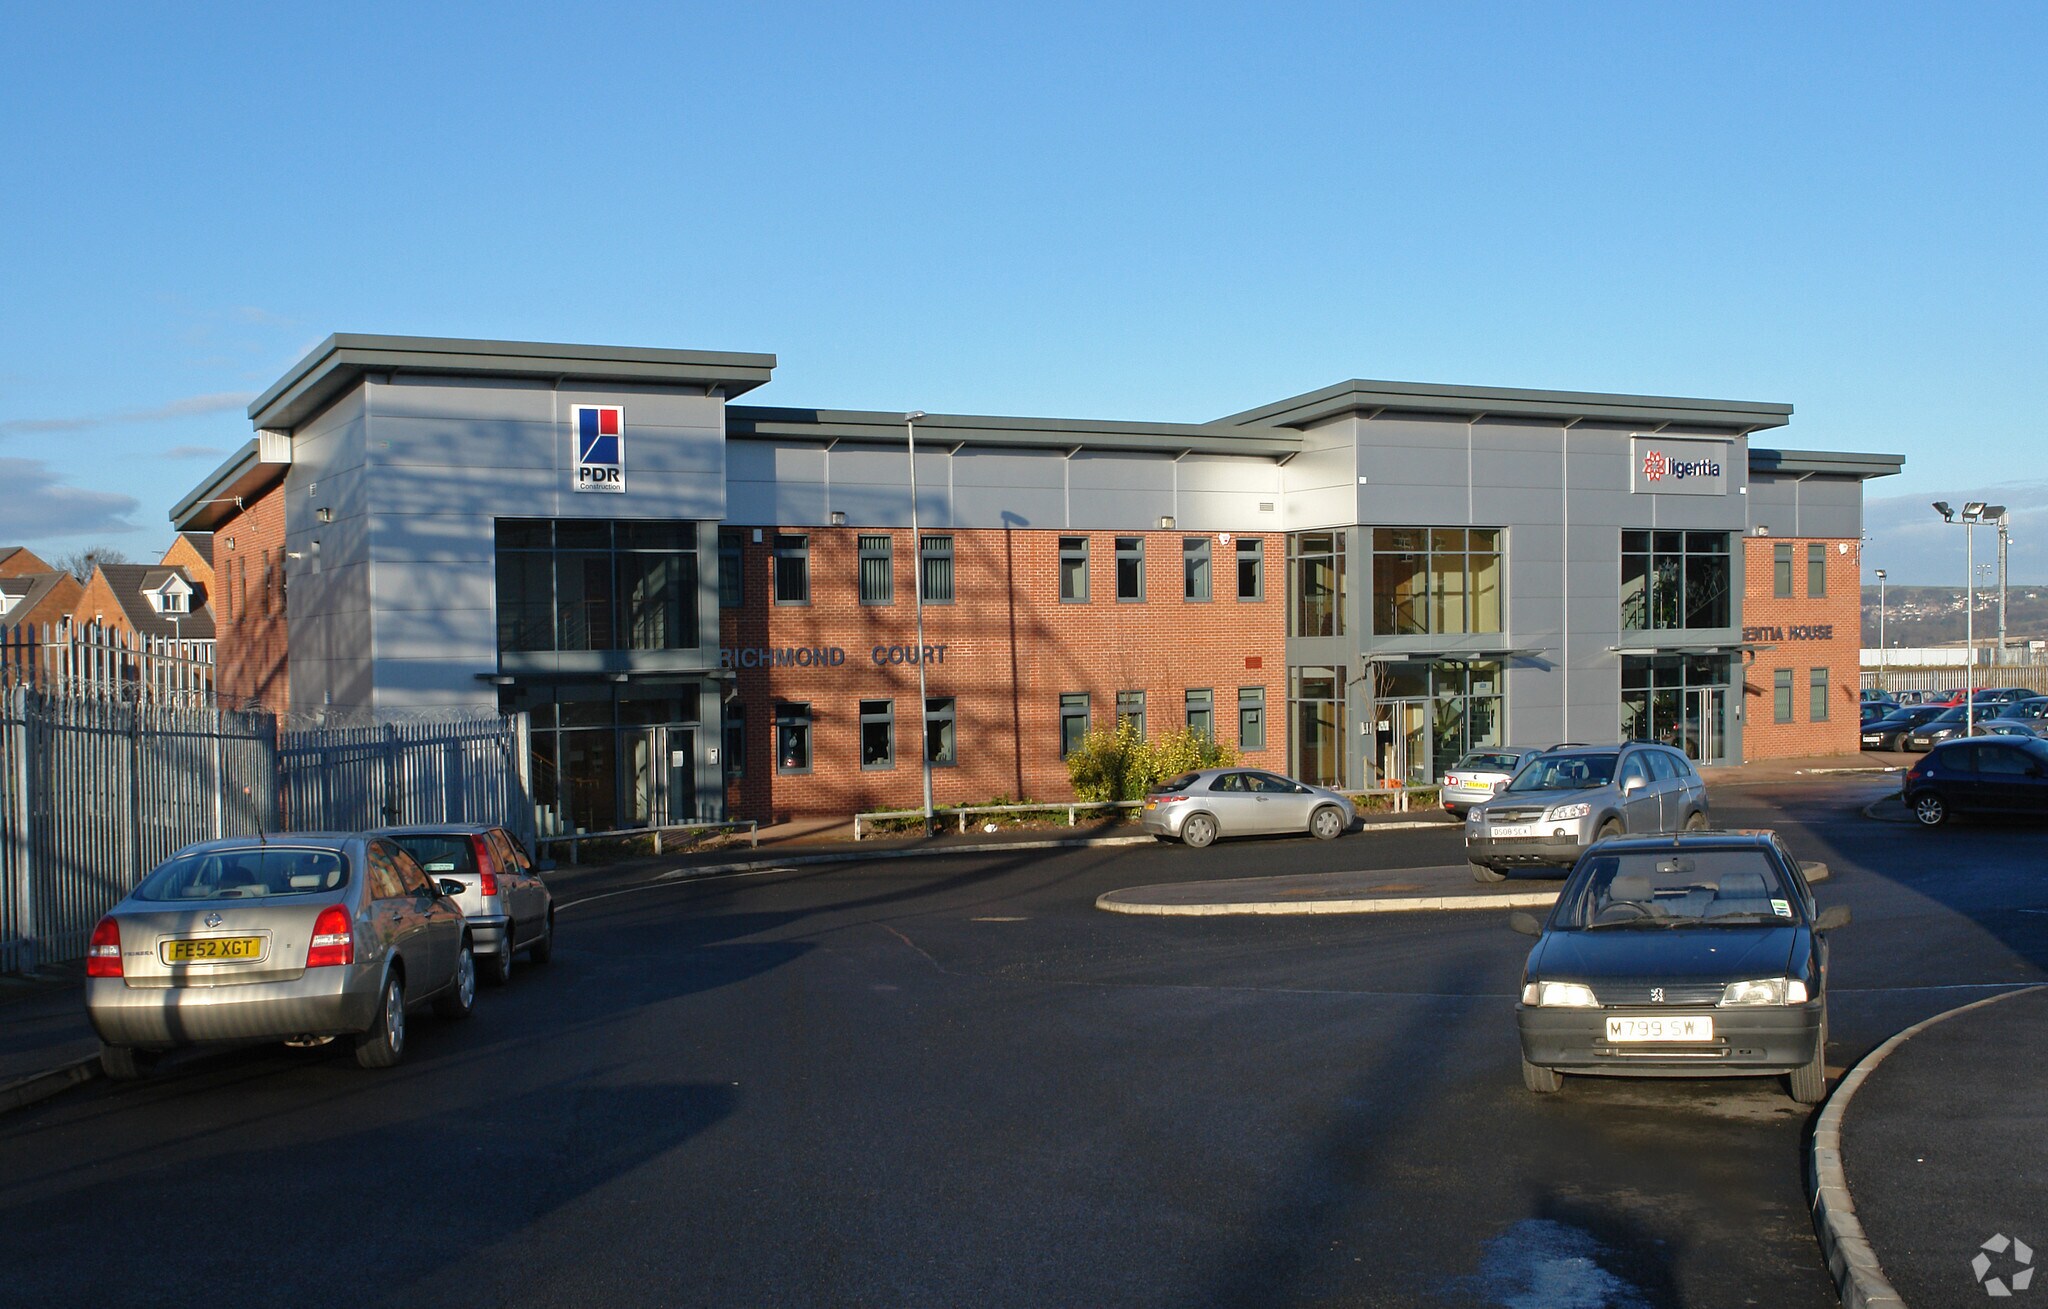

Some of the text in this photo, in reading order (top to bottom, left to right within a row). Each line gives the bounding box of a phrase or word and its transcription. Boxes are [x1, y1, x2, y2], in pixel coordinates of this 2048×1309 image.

[579, 467, 620, 482] PDR
[1667, 457, 1720, 479] ligentia
[1788, 625, 1834, 641] HOUSE
[719, 645, 948, 668] RICHMOND COURT
[175, 940, 253, 958] FE52 XGT
[1610, 1021, 1663, 1037] M799
